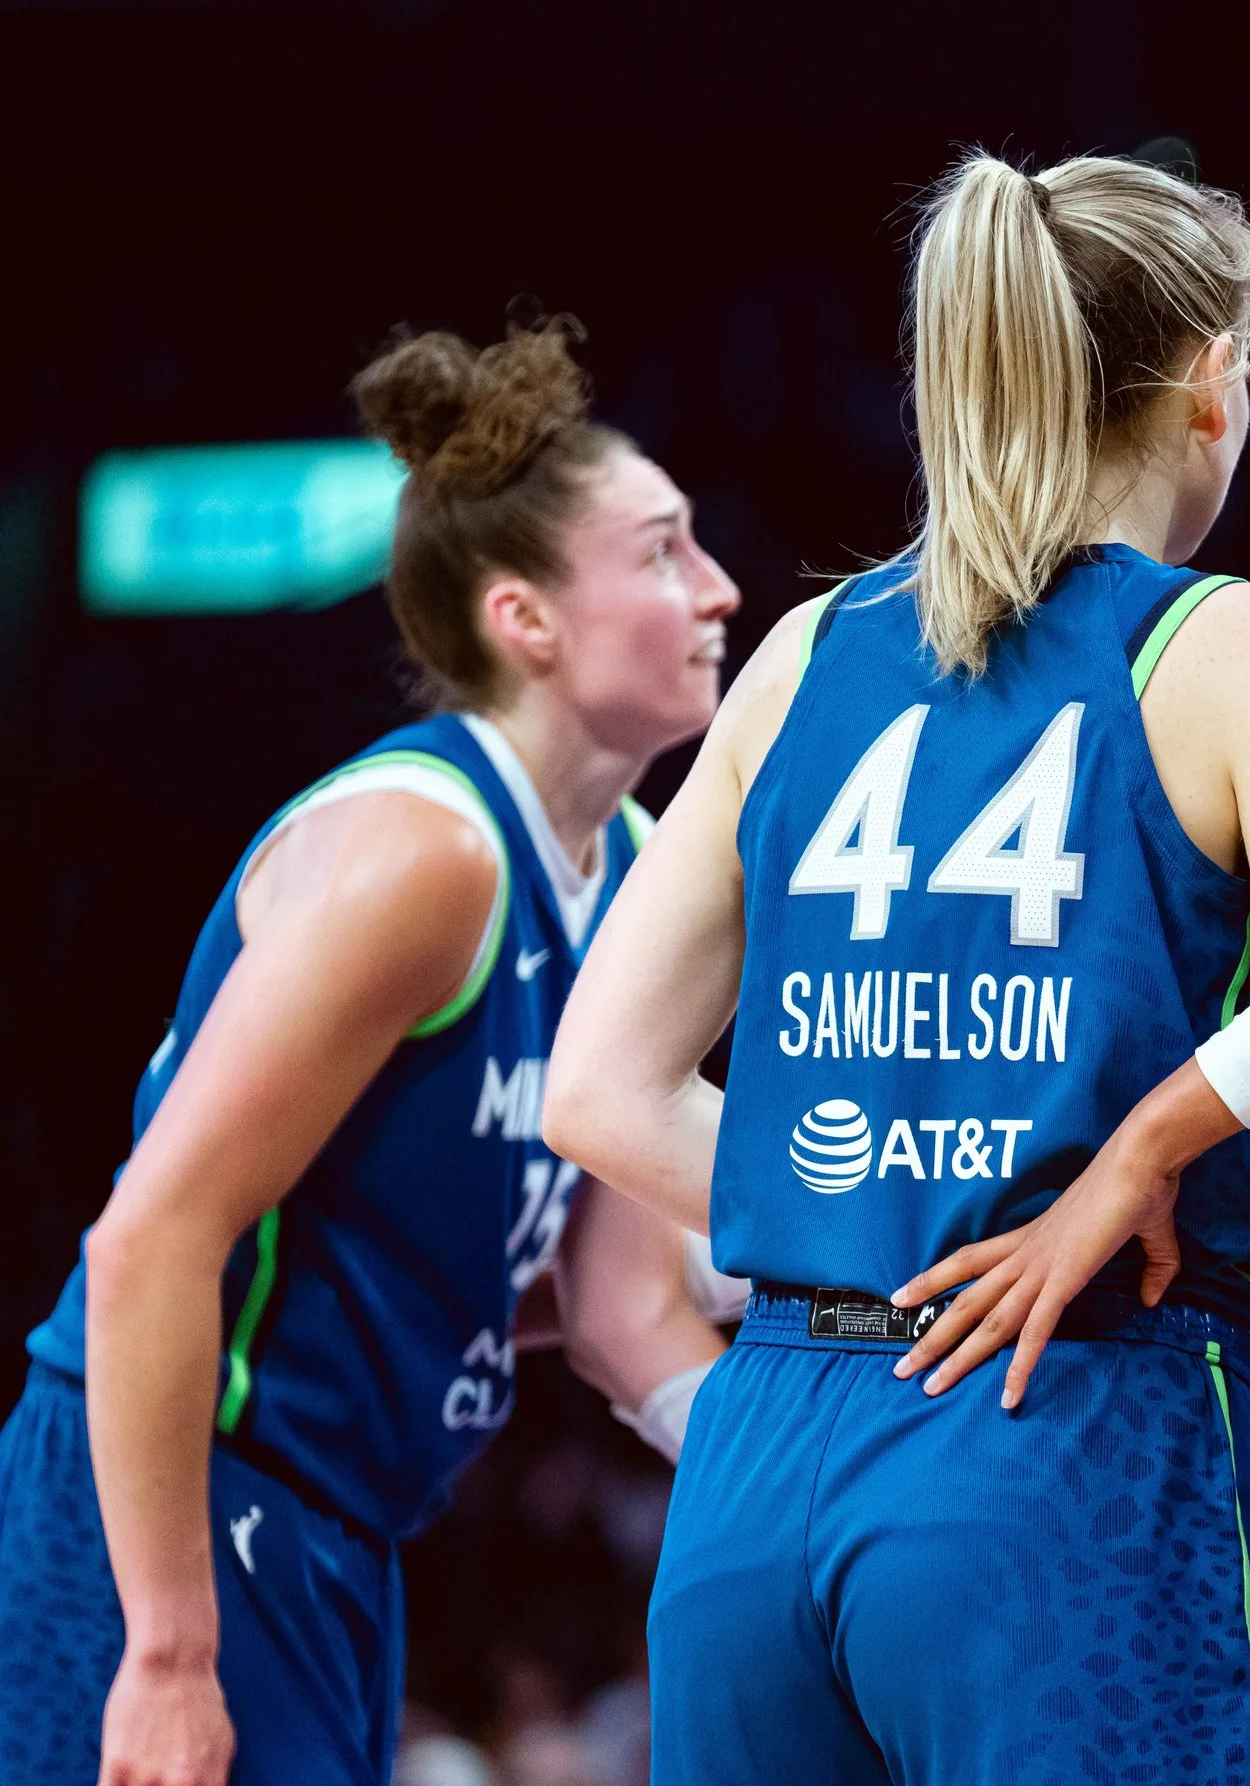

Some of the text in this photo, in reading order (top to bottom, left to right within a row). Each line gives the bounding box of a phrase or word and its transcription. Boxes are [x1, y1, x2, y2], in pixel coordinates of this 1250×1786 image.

[788, 702, 1086, 947] 44
[779, 970, 1073, 1063] SAMUELSON
[878, 1118, 1033, 1180] AT&T
[840, 1324, 886, 1333] ENGINEERED
